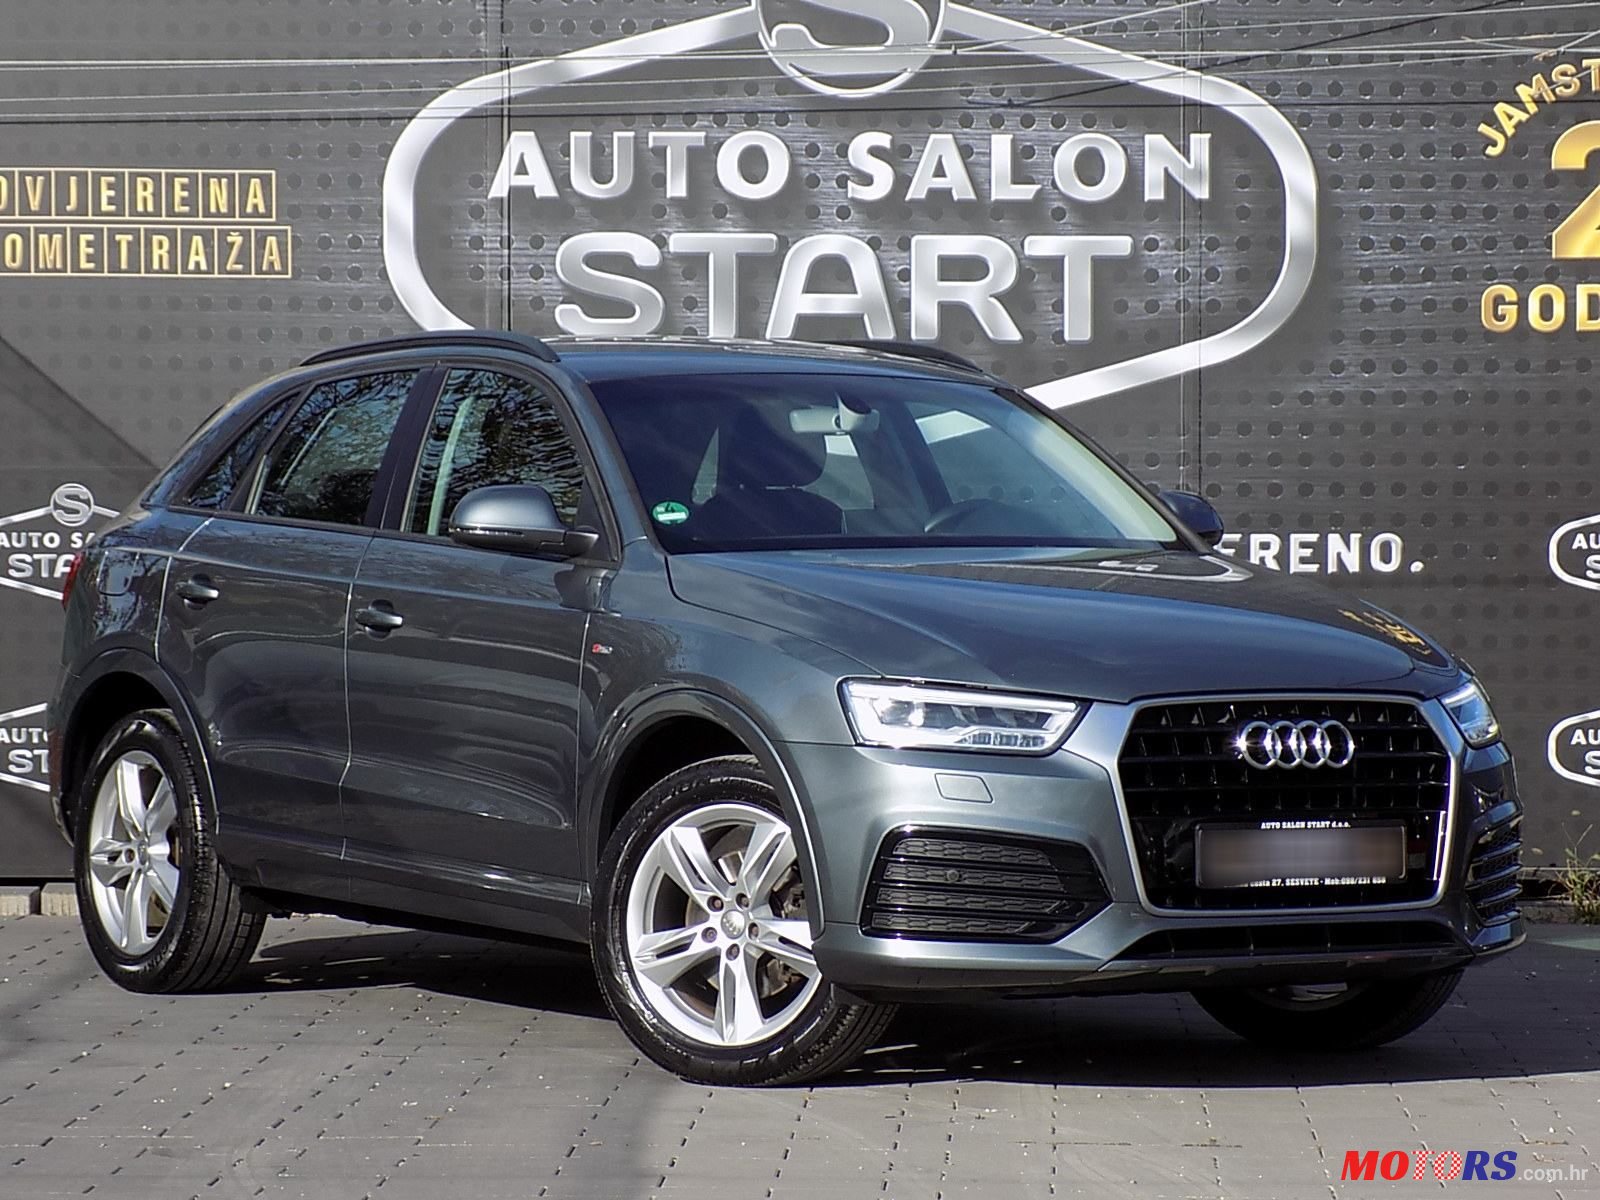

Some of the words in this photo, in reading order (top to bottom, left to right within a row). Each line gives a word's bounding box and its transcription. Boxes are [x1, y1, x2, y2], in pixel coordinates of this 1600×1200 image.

[487, 130, 790, 200] AUTO
[846, 130, 1212, 202] SALON
[4, 231, 282, 272] OMETRAŽA
[554, 231, 1134, 343] START
[1480, 283, 1600, 332] GOD
[0, 532, 60, 549] AUTO
[1261, 822, 1281, 830] AUTO
